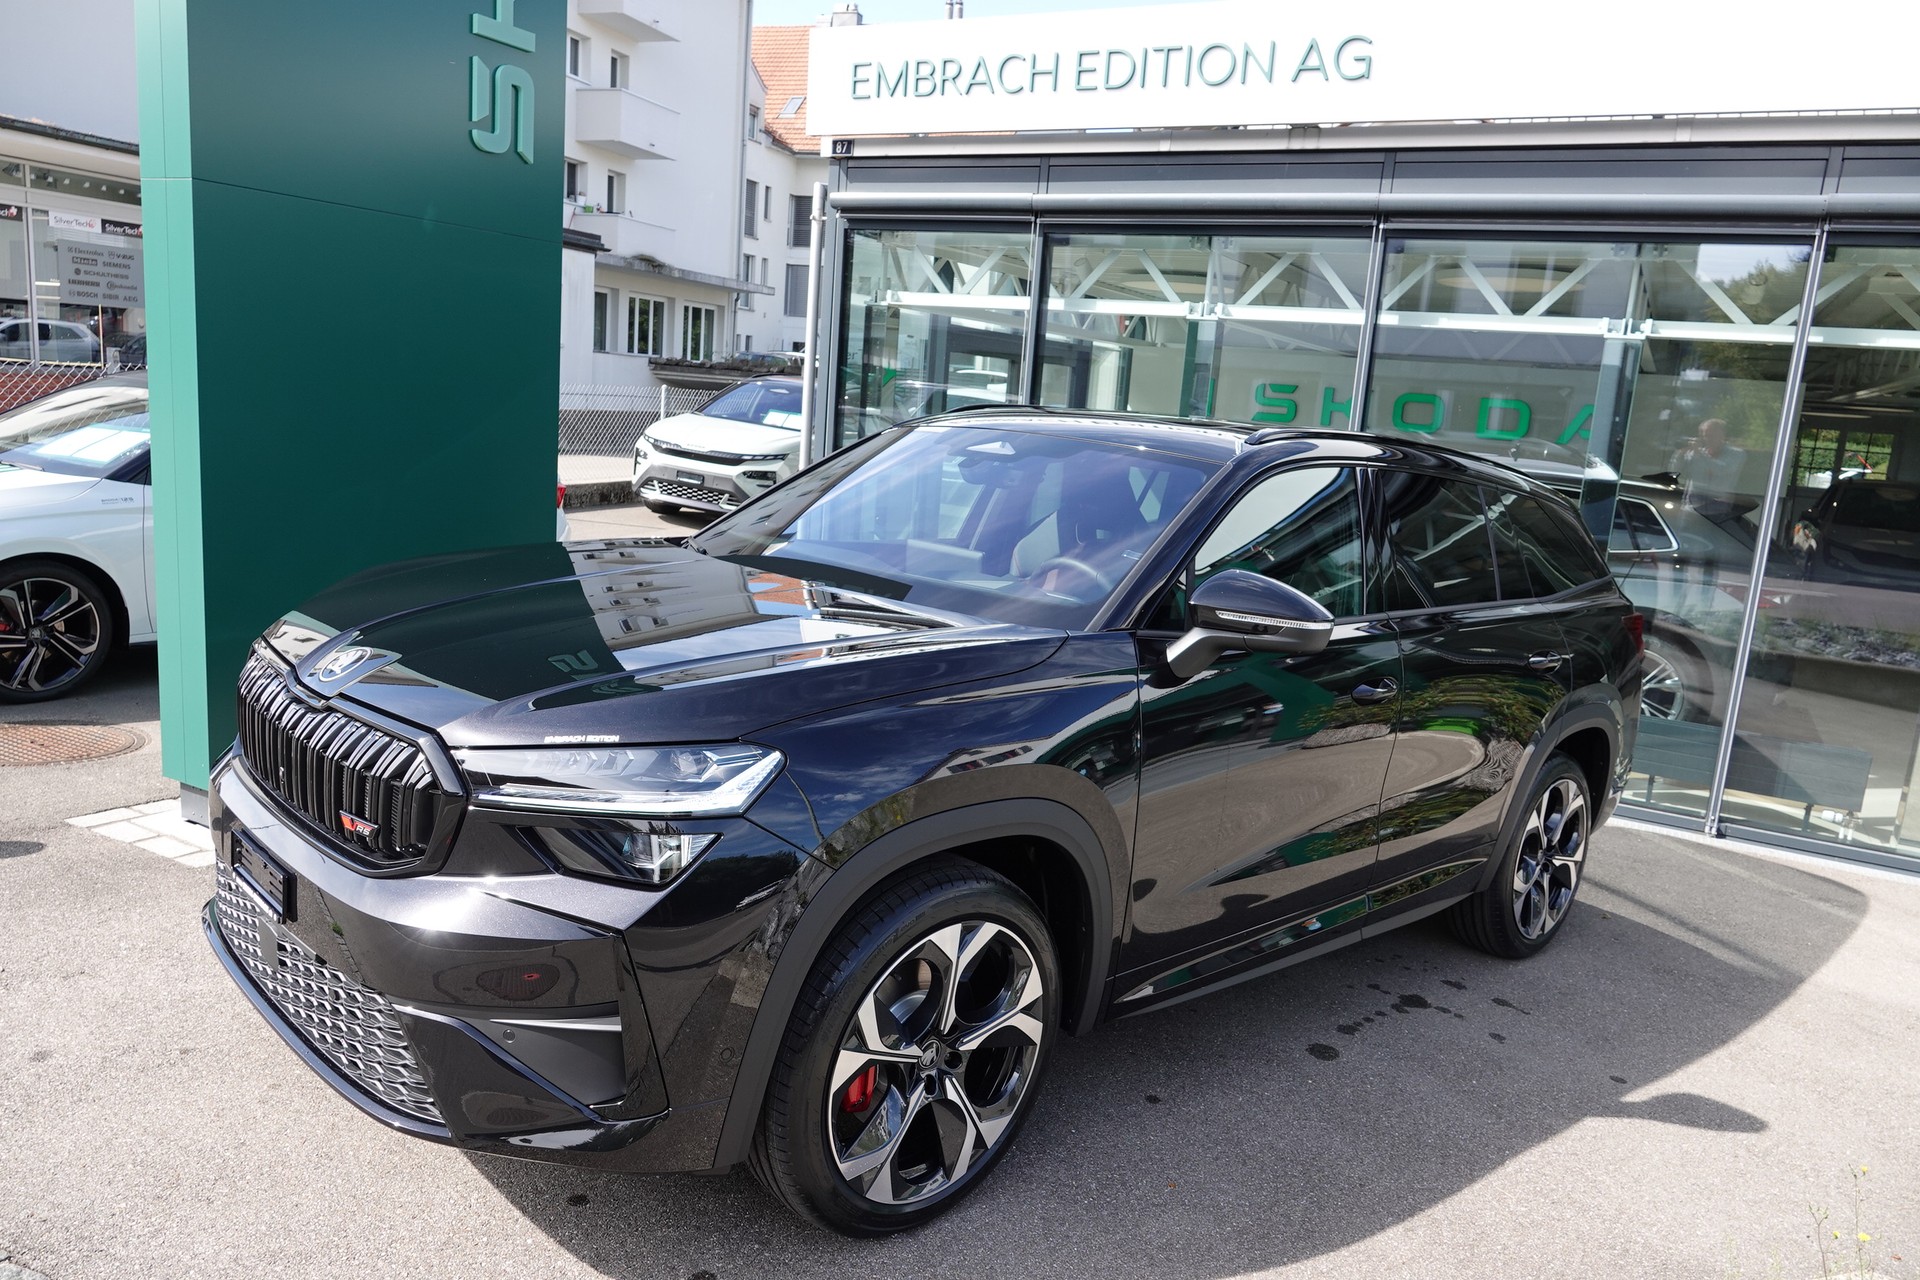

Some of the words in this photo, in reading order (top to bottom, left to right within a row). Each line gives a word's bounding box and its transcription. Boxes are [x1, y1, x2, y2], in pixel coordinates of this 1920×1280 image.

[851, 51, 1060, 100] EMBRACH
[1074, 40, 1277, 93] EDITION
[1291, 34, 1374, 83] AG
[836, 141, 849, 154] 87
[102, 261, 131, 270] SIEMENS
[76, 290, 98, 299] BOSCH
